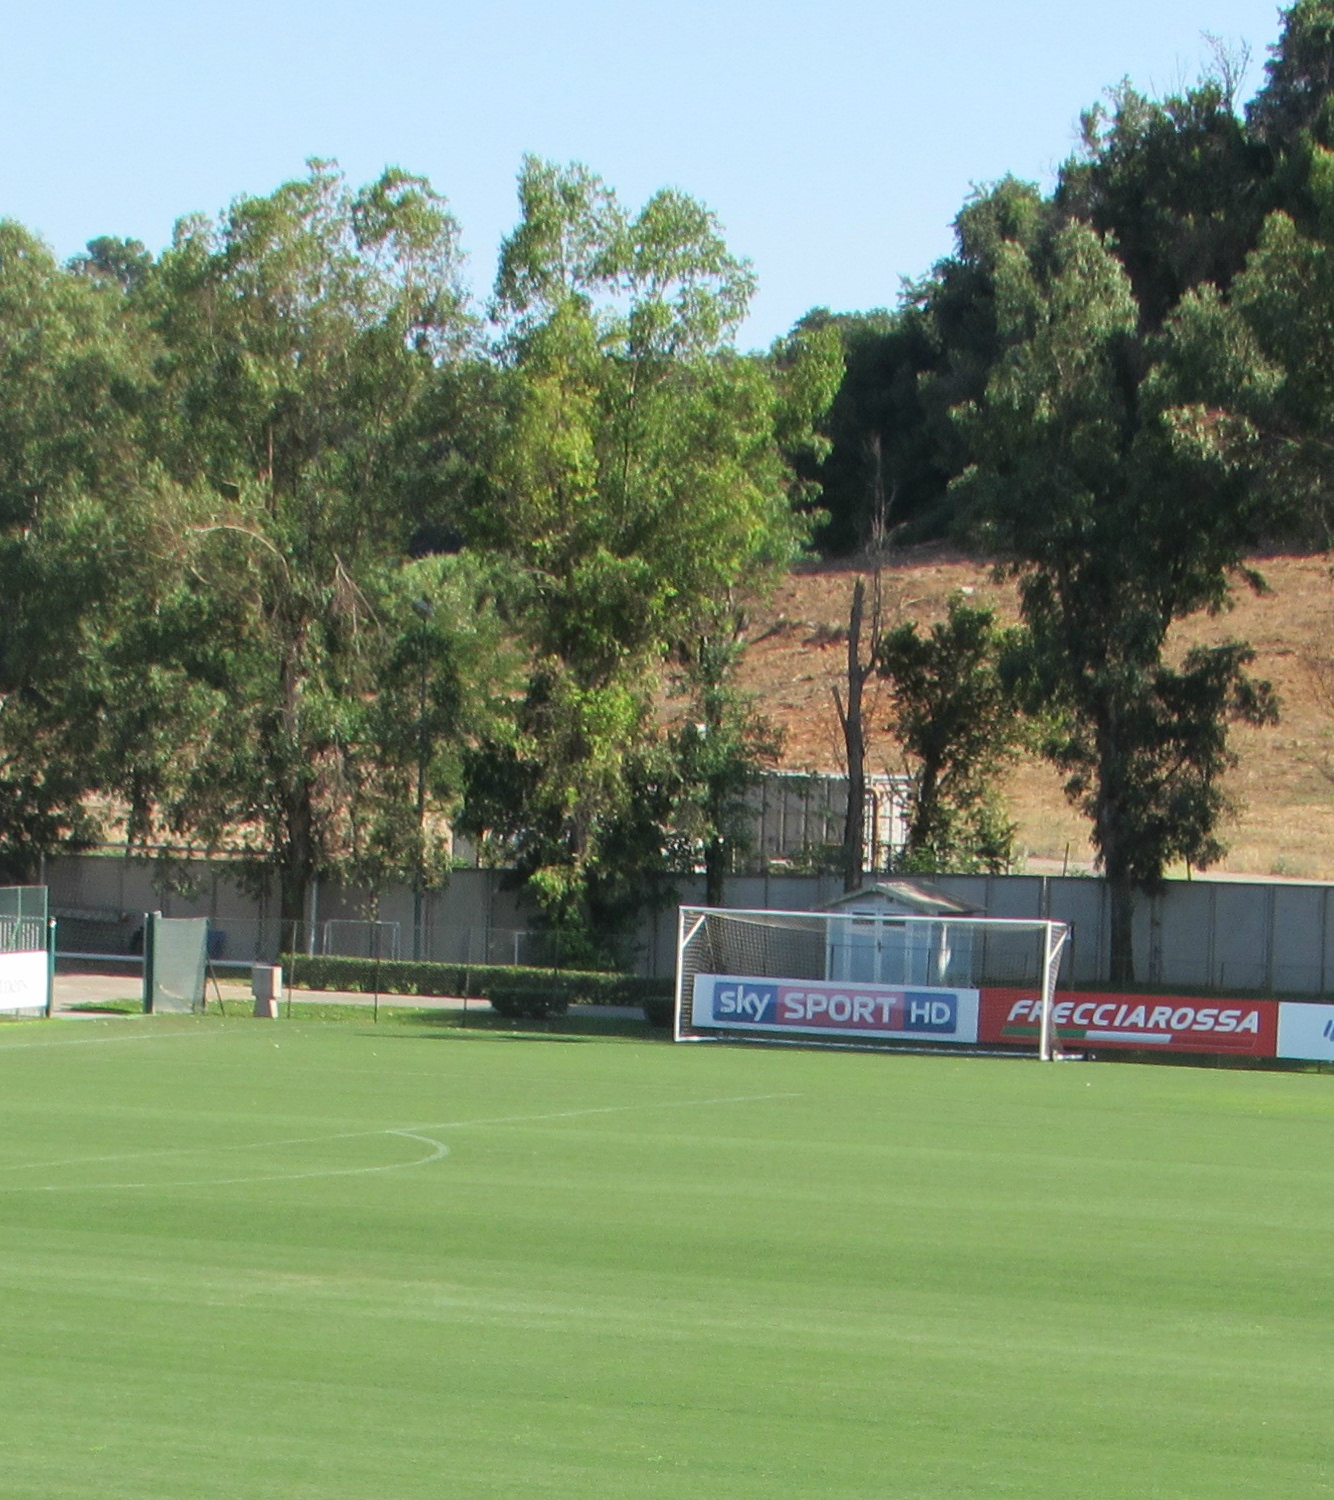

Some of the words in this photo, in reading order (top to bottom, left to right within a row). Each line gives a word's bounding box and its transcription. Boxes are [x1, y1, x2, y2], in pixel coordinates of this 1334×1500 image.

[720, 984, 771, 1022] sky
[782, 991, 899, 1024] SPORT
[910, 998, 952, 1026] HD
